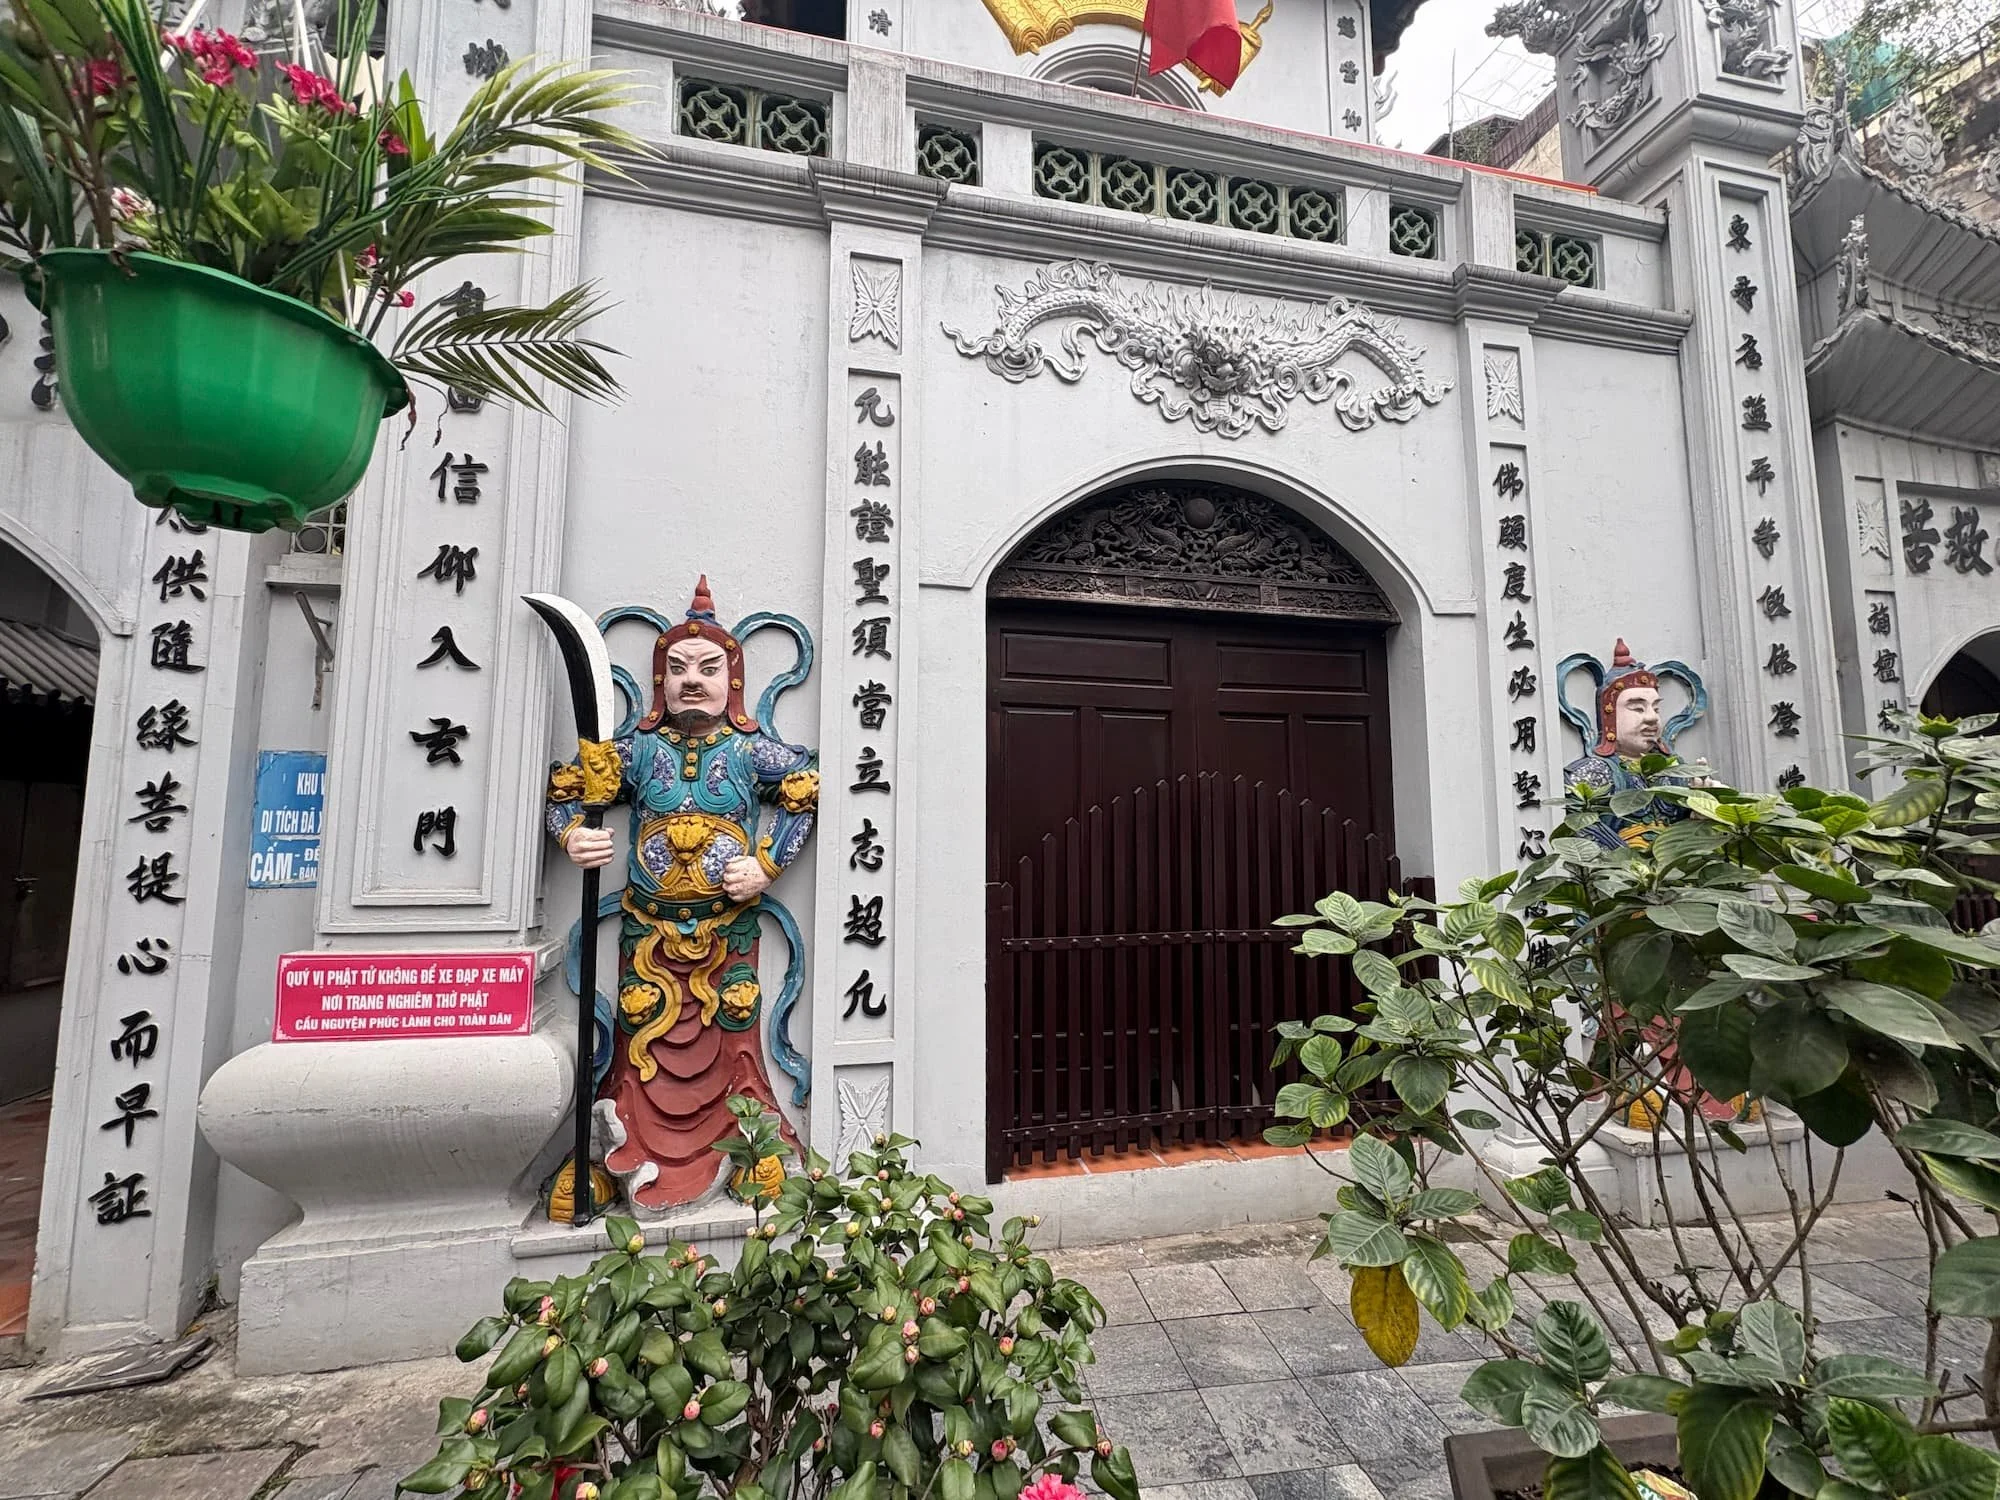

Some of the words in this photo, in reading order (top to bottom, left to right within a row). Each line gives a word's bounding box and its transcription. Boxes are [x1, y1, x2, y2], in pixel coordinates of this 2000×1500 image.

[297, 772, 318, 795] KHU
[275, 805, 299, 833] TÍCH
[250, 842, 293, 882] CẤM
[286, 968, 310, 988] QUÝ
[313, 970, 324, 989] VỊ
[327, 967, 358, 989] PHẬT
[361, 965, 377, 985] TỬ
[378, 966, 417, 985] KHÔNG
[438, 968, 453, 984] XE
[456, 968, 479, 986] ĐẠP
[482, 968, 496, 983] XE
[500, 965, 524, 983] MÁY
[322, 993, 343, 1011] NƠI
[346, 994, 384, 1010] TRANG
[387, 990, 433, 1010] NGHIÊM
[459, 990, 489, 1010] PHẬT
[321, 1016, 366, 1032] NGUYỆN
[369, 1015, 399, 1029] PHÚC
[402, 1014, 431, 1028] LÀNH
[433, 1014, 456, 1027] CHO
[459, 1013, 486, 1025] TOÀN
[489, 1012, 512, 1025] DÂN
